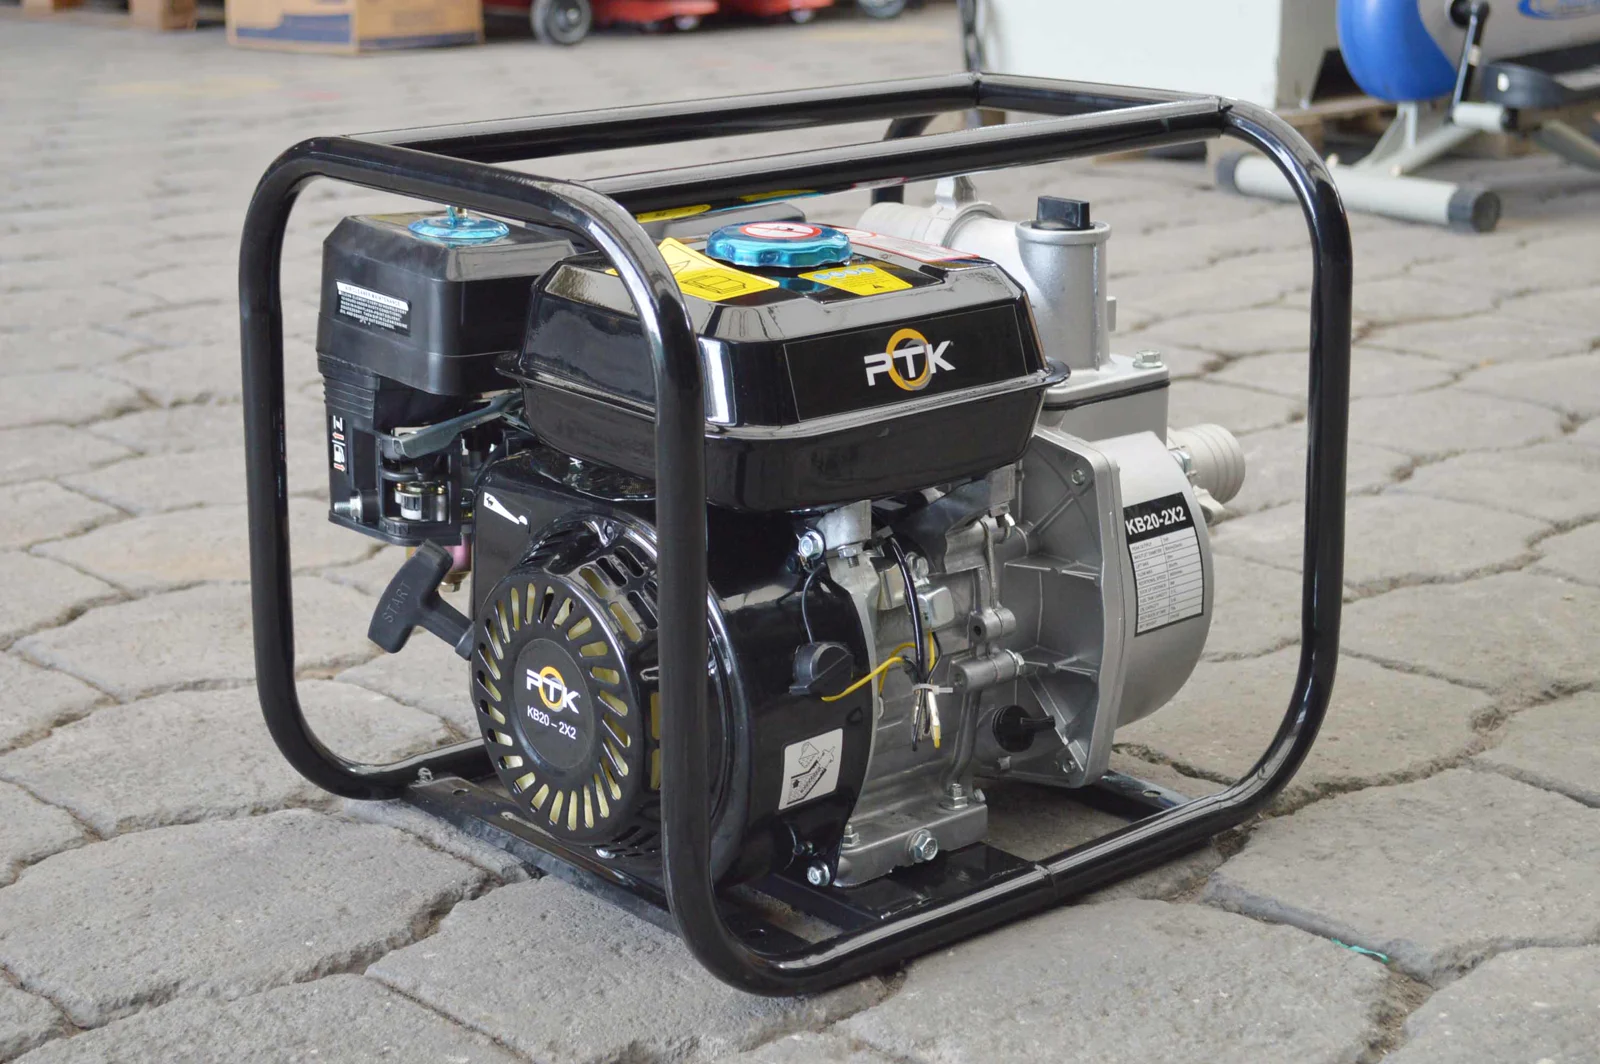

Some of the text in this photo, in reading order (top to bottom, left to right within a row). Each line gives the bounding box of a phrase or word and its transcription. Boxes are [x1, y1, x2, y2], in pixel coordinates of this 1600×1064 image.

[863, 334, 956, 388] PTK
[1125, 506, 1187, 536] KB20-2X2
[383, 580, 411, 623] START
[526, 667, 581, 714] PTK
[558, 721, 577, 740] 2X2
